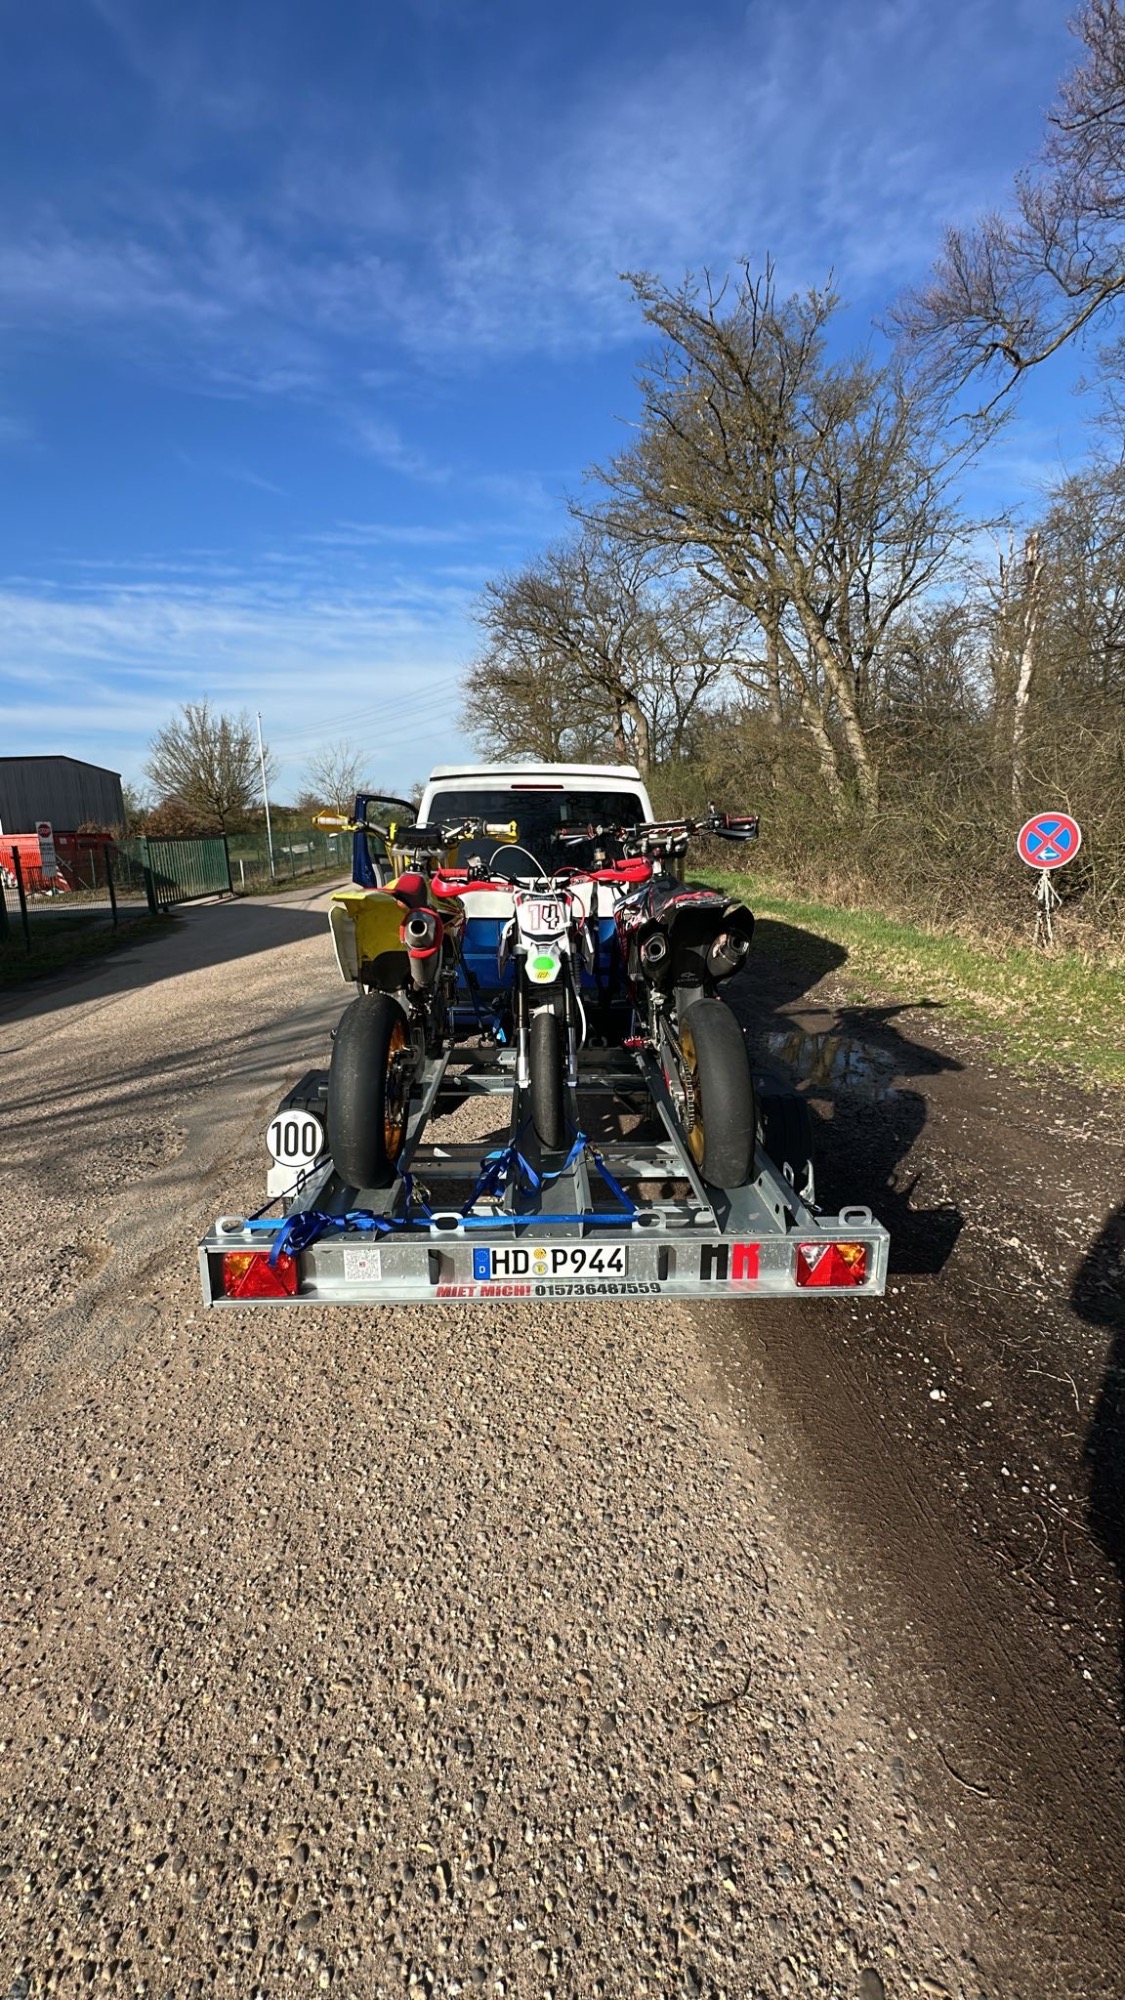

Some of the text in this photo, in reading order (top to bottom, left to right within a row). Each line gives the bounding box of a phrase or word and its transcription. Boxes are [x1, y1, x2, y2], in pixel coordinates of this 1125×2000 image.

[528, 904, 560, 930] 14
[272, 1121, 316, 1156] 100
[478, 1266, 485, 1274] D
[492, 1248, 623, 1275] HD P944
[435, 1285, 477, 1297] MIET
[535, 1282, 661, 1296] 015736487559
